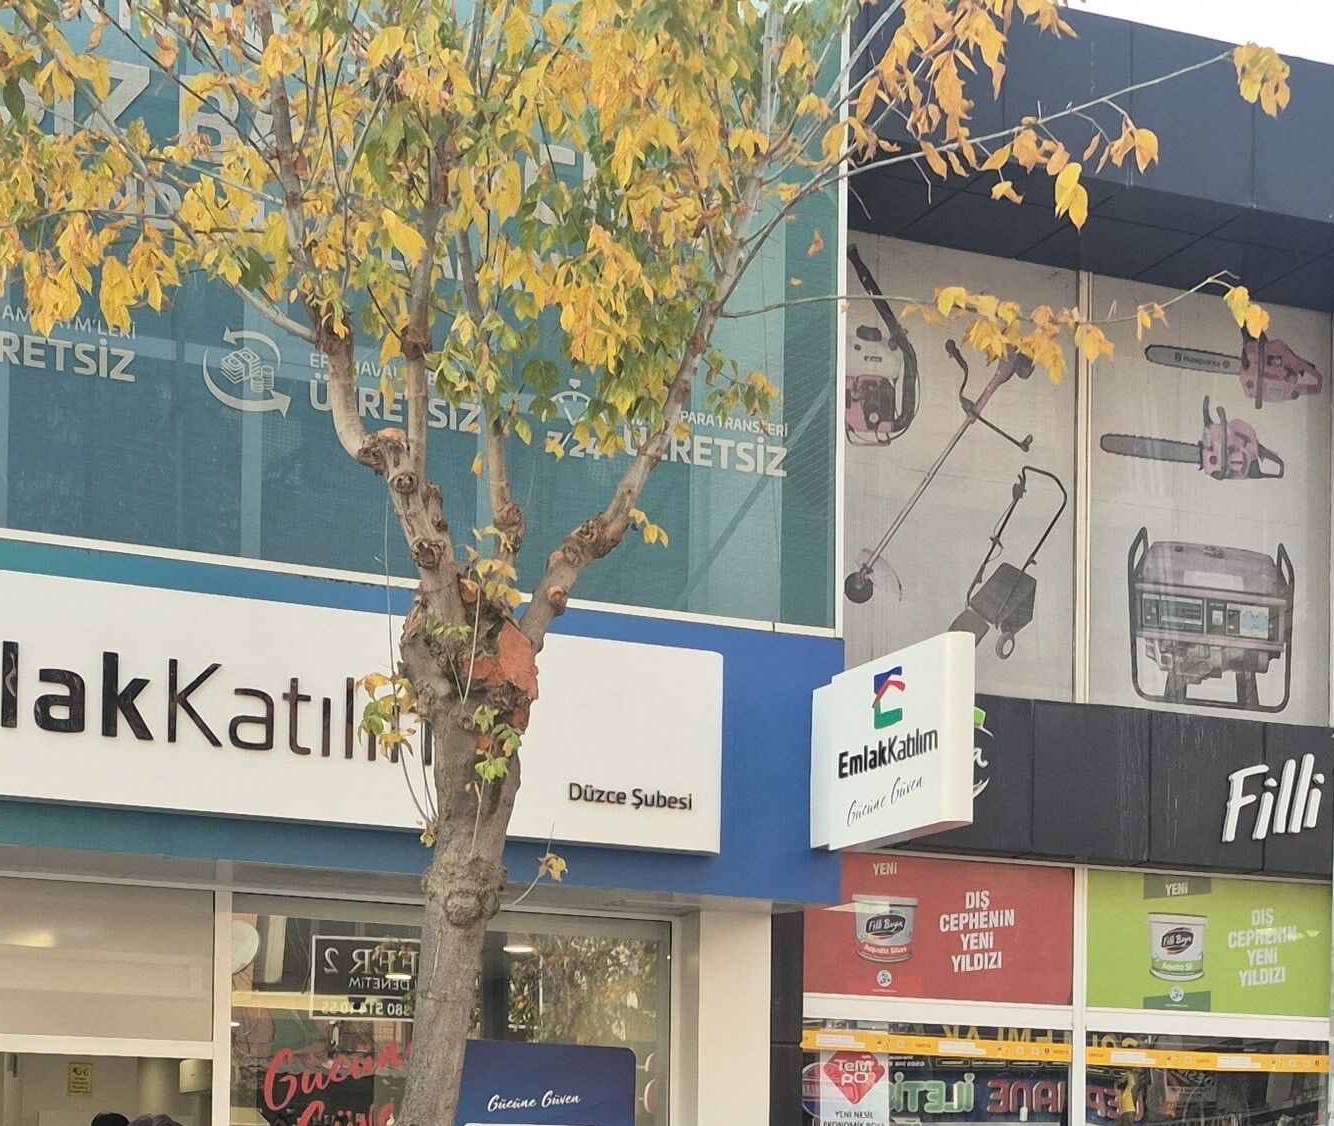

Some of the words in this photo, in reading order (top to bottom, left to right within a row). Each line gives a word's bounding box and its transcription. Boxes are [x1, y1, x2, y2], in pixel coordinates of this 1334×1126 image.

[309, 373, 481, 434] ÜRESİZ
[681, 410, 715, 428] PARA
[623, 418, 788, 478] ÜRETSİZ
[838, 727, 939, 780] EmlakKatılım
[569, 782, 627, 805] Düzce
[631, 788, 693, 811] Şubesi
[1222, 753, 1325, 842] Filli
[873, 861, 897, 876] YENİ
[965, 890, 990, 909] DIŞ
[1165, 881, 1188, 896] YENİ
[939, 908, 1015, 933] CEPHENİN
[960, 931, 994, 951] YENİ
[951, 951, 1003, 973] YILDIZI
[1247, 947, 1278, 967] YENİ
[1239, 966, 1287, 988] YILDIZI
[264, 1040, 413, 1111] Gücün
[487, 1094, 537, 1112] Gücüne
[541, 1090, 581, 1108] Güven
